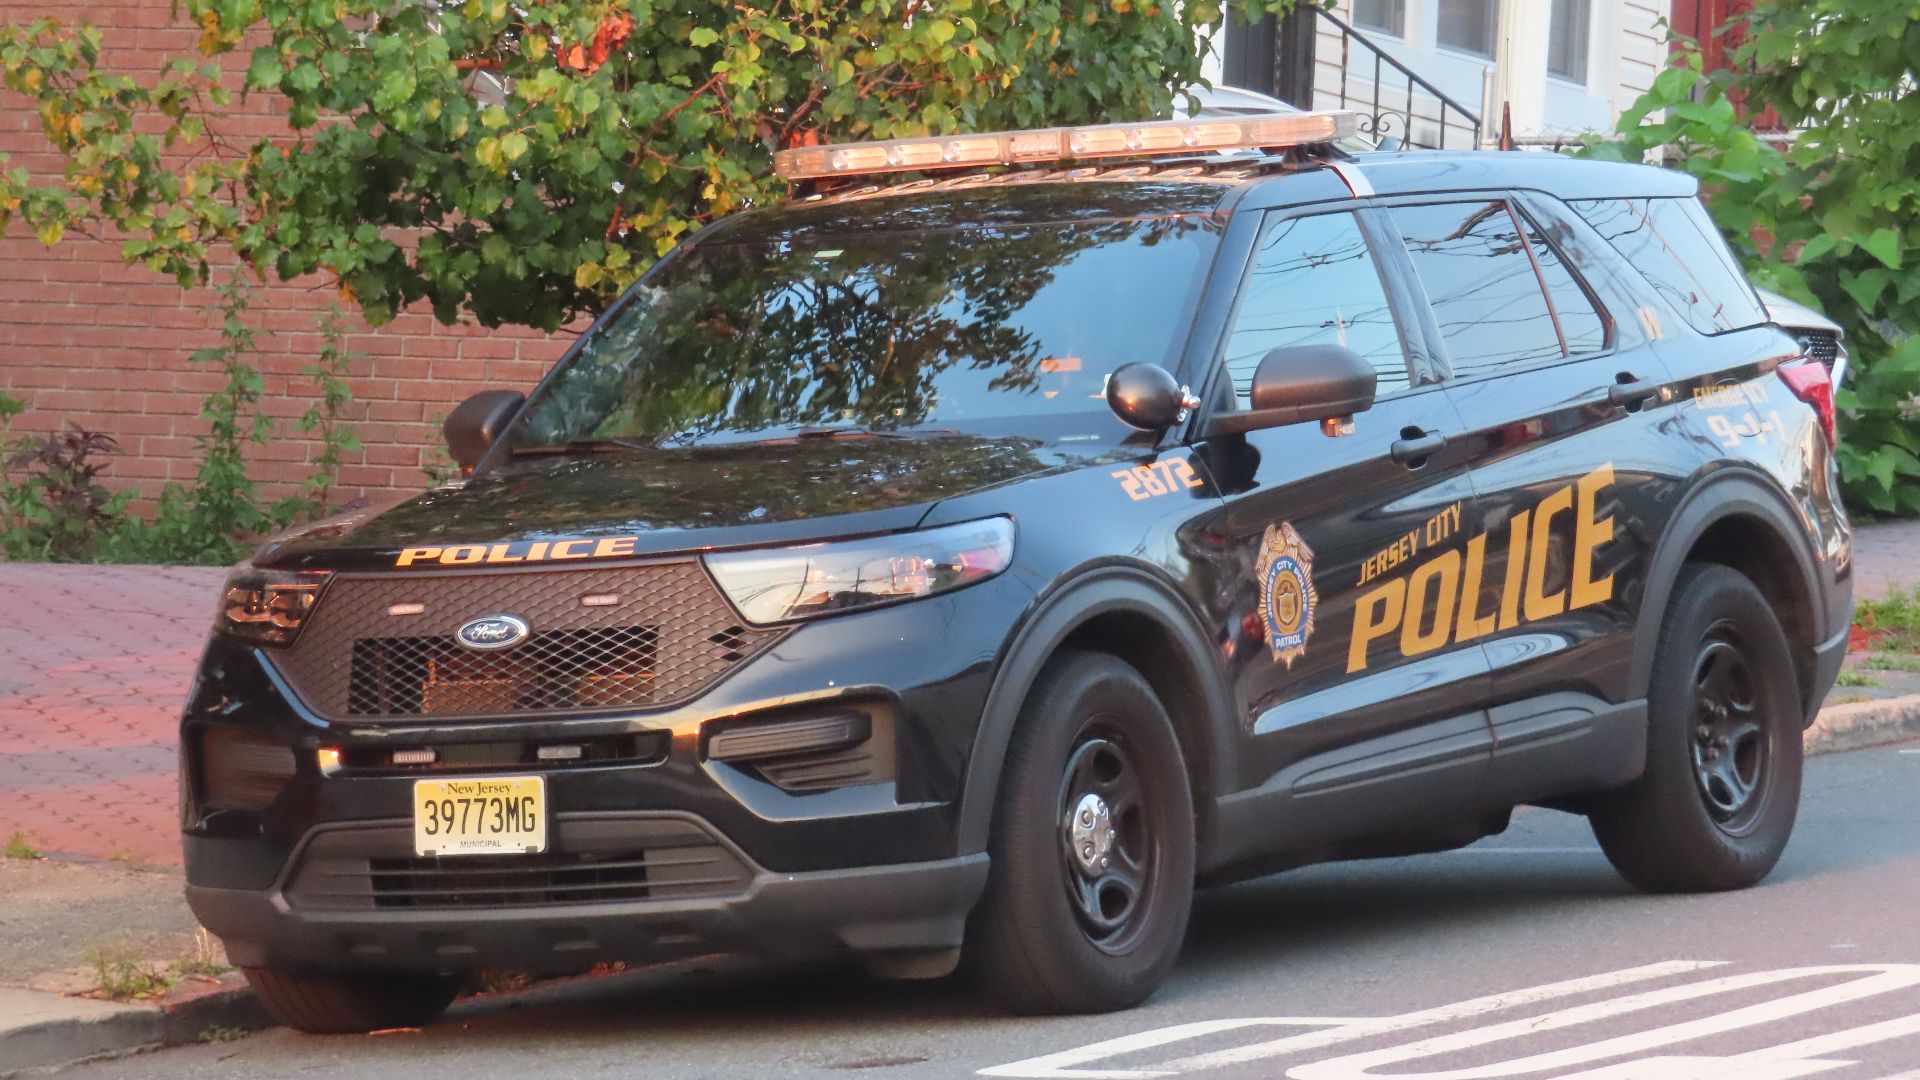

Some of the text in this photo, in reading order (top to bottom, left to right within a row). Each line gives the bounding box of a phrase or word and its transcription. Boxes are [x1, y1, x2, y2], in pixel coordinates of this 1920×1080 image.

[1707, 409, 1789, 448] 9-1-1
[1111, 457, 1203, 501] 2872
[396, 537, 638, 566] POLICE
[1356, 500, 1461, 586] JERSEY CITY
[1276, 560, 1293, 571] CITY
[1294, 567, 1308, 611] POLICE
[1346, 461, 1615, 673] POLICE
[471, 622, 509, 640] Ford
[1275, 634, 1302, 649] PATROL
[447, 782, 511, 796] New Jersey
[424, 796, 536, 835] 39773MG
[459, 840, 502, 849] MUNICIPAL
